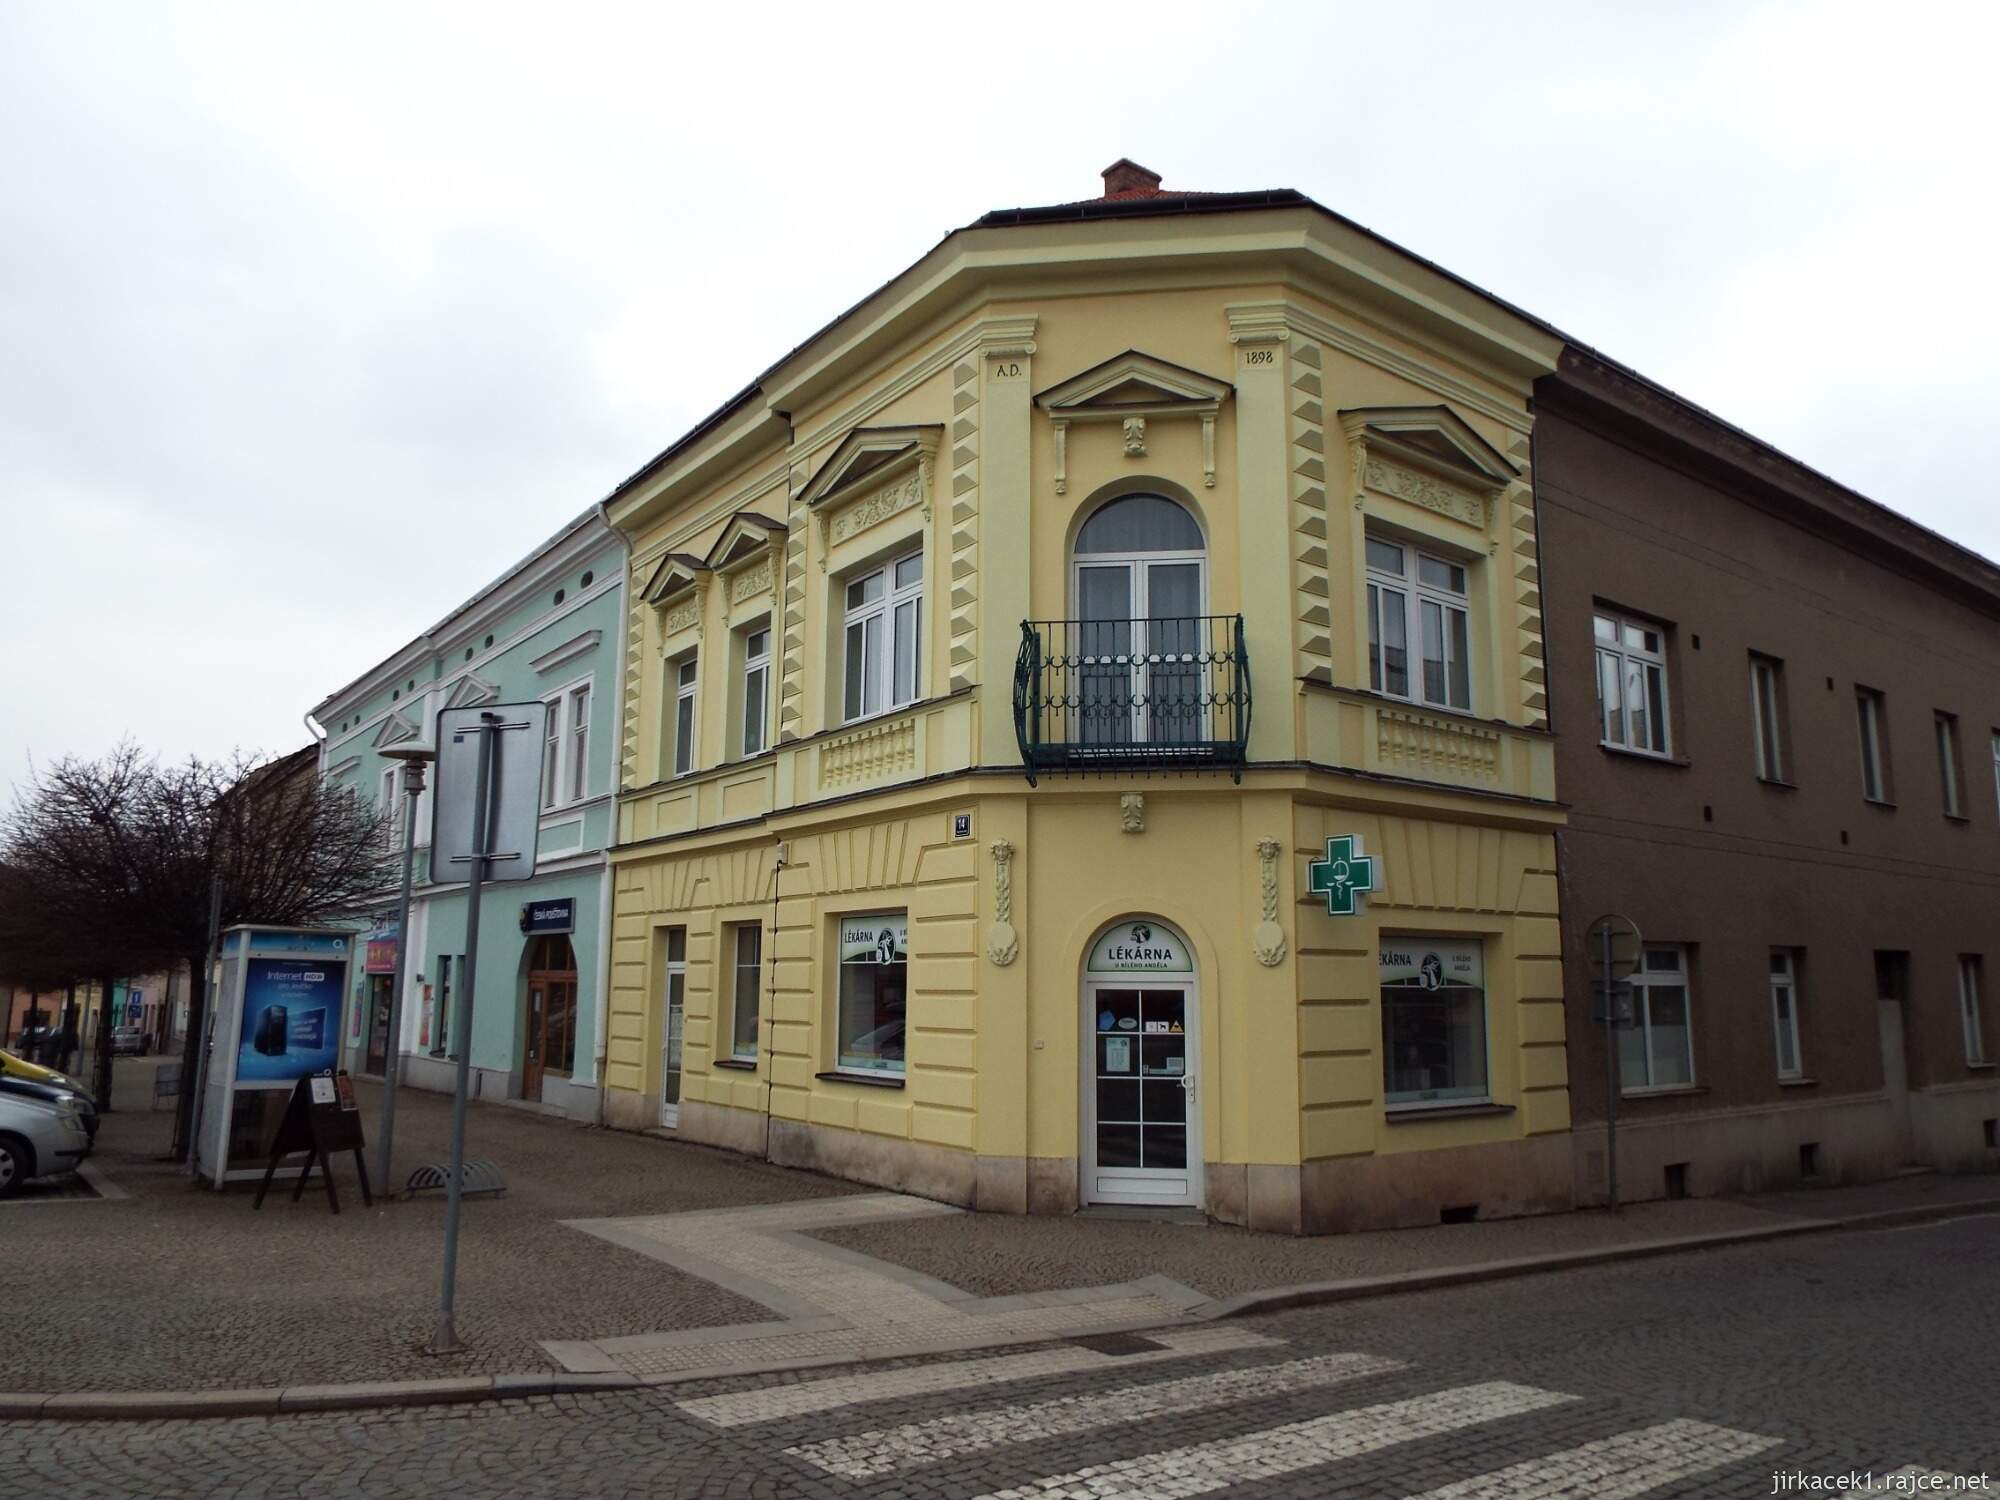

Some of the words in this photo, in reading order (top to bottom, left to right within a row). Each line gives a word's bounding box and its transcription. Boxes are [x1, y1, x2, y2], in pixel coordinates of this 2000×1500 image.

[1246, 351, 1273, 364] 1898
[996, 364, 1022, 377] A.D.
[958, 817, 965, 829] 14
[844, 929, 874, 943] LÉKÁRNA
[1108, 945, 1172, 960] LÉKÁRNA
[267, 970, 302, 980] Internet
